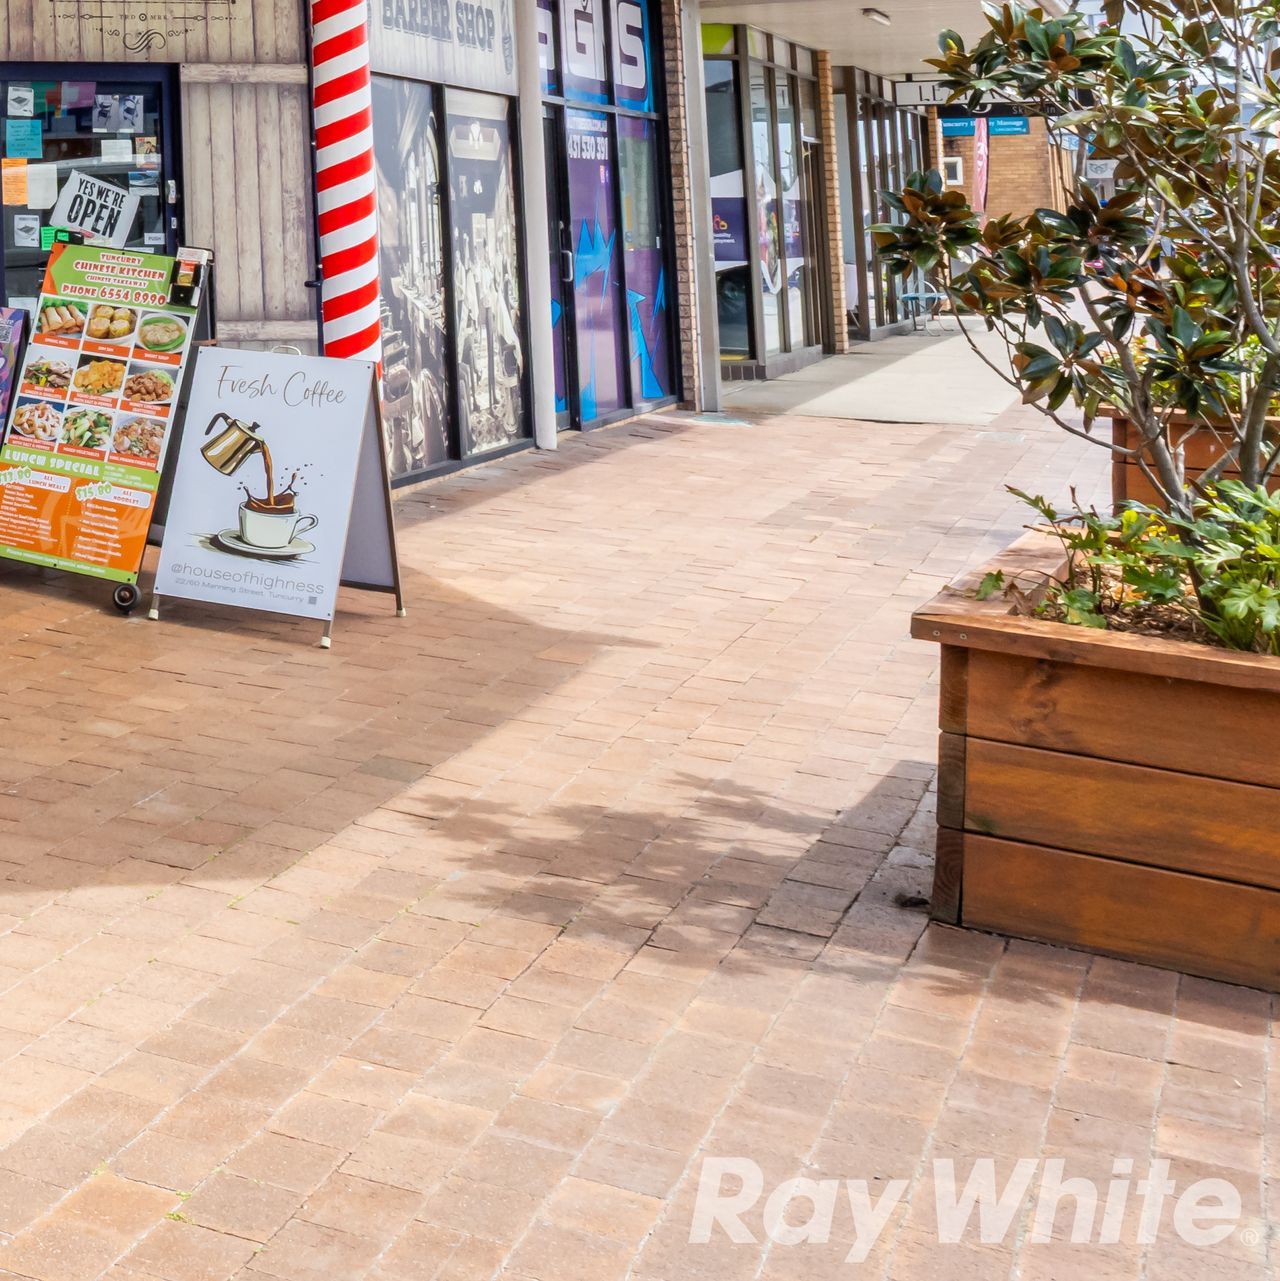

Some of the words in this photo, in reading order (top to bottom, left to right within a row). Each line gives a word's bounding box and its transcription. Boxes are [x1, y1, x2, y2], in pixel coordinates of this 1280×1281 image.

[455, 0, 495, 53] SHOP
[78, 178, 94, 197] YES
[96, 185, 126, 209] WE'RE
[67, 194, 121, 238] OPEN
[74, 261, 118, 273] CHINESE
[119, 265, 165, 280] KITCHEN
[100, 253, 143, 265] TUNCURRY
[61, 284, 97, 297] PHONE
[99, 287, 130, 301] 6554
[133, 291, 168, 306] 8990
[217, 365, 277, 399] Fresh
[283, 371, 347, 408] Coffee
[4, 449, 46, 466] LUNCH
[50, 457, 100, 476] SPECIAL
[171, 562, 324, 595] @houseofhighness
